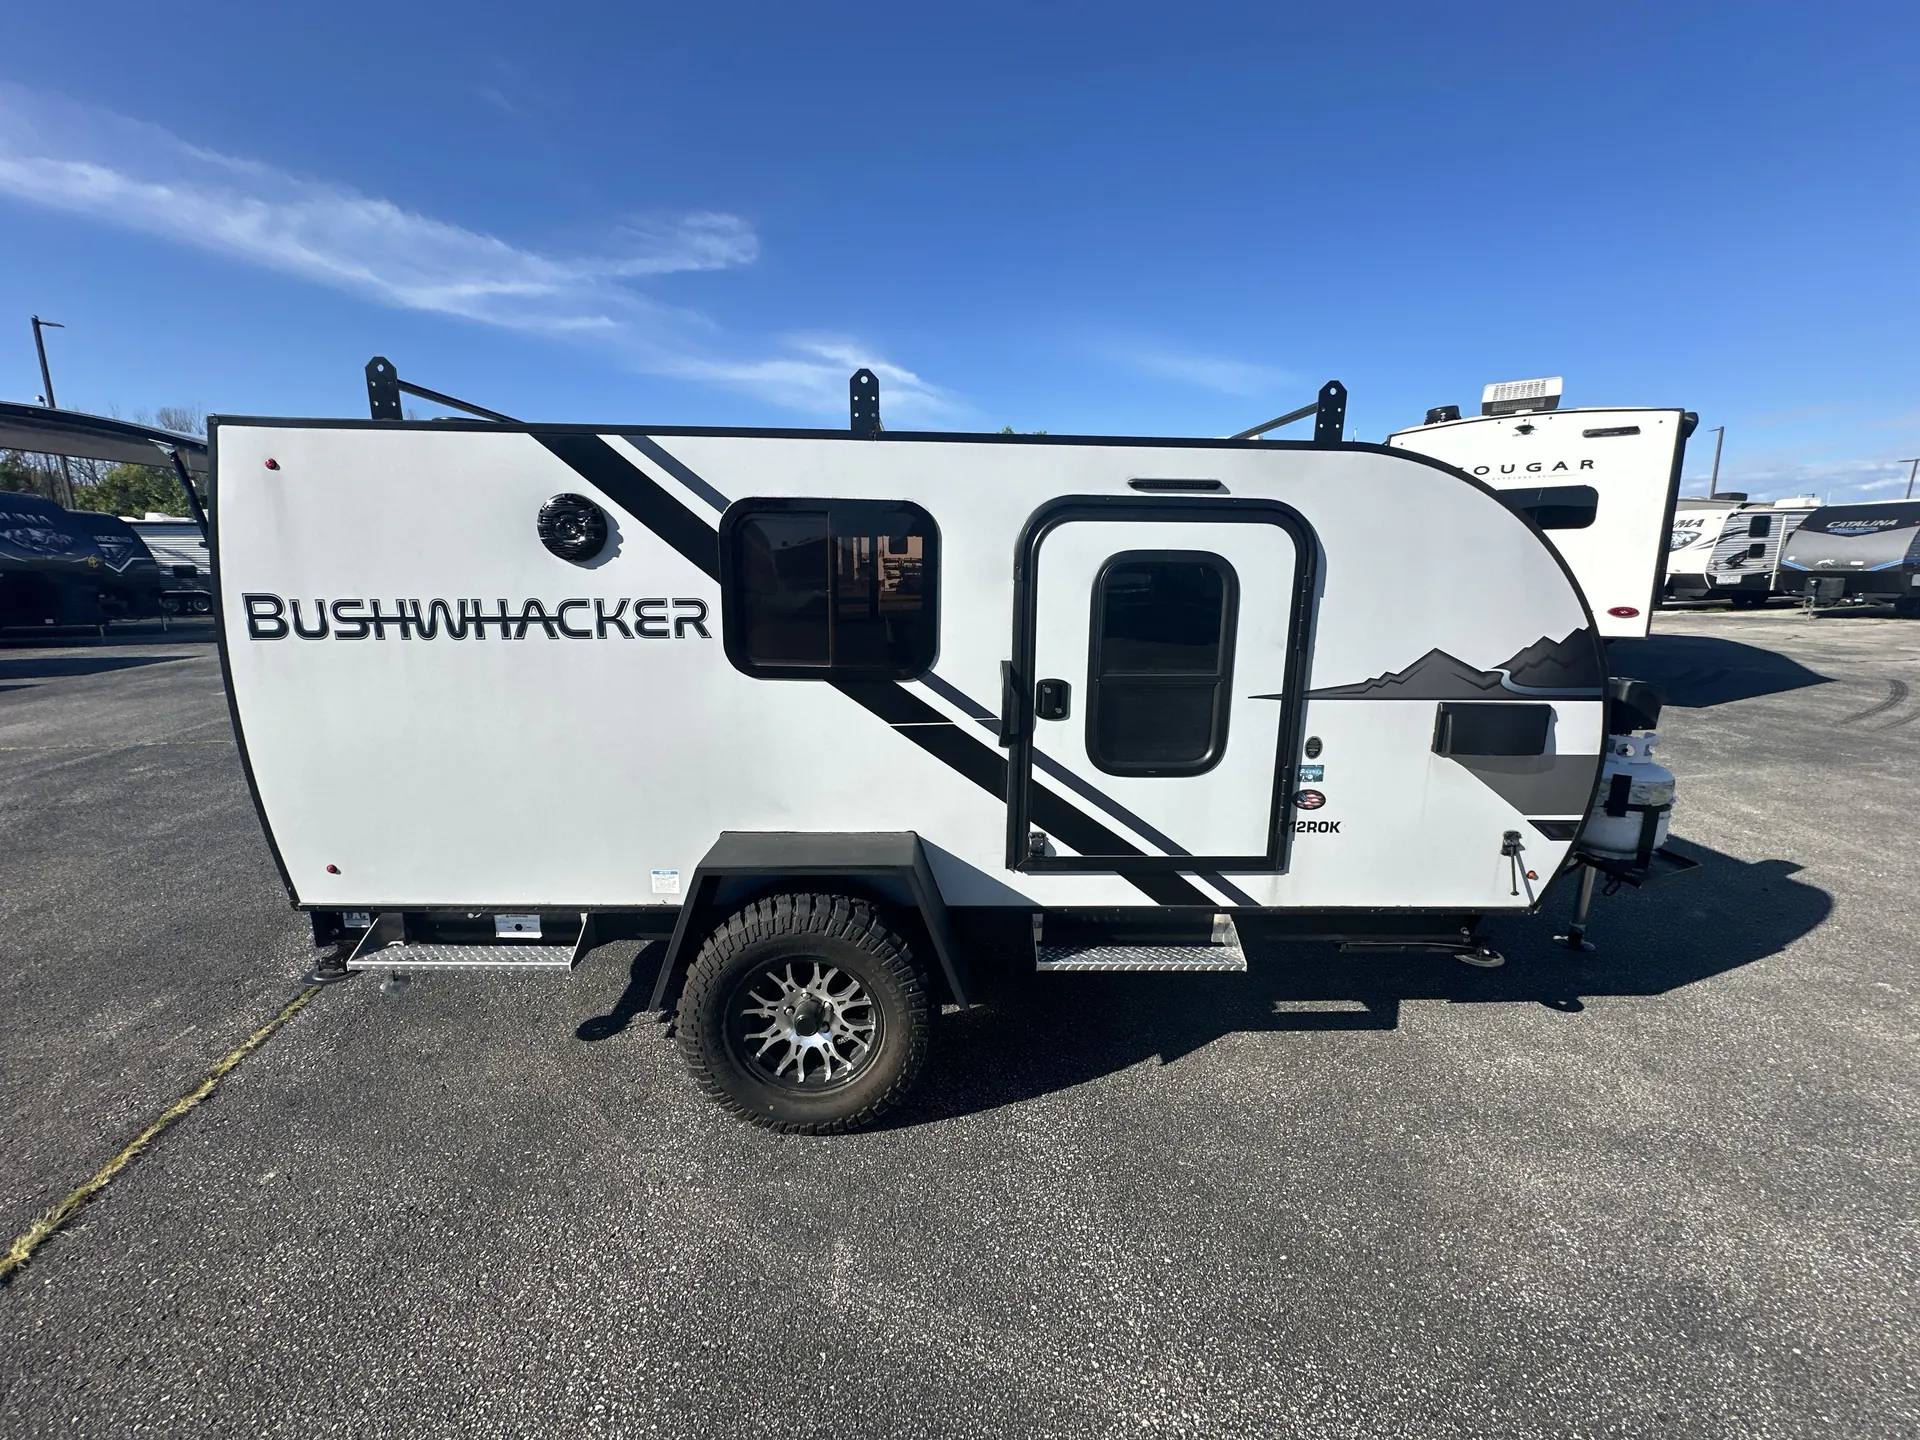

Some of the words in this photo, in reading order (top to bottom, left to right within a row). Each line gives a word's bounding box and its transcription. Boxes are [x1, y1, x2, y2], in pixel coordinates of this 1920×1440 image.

[1456, 459, 1594, 476] OUGAR
[1826, 519, 1899, 528] CATALINA
[241, 592, 713, 640] BUSHWHACKER
[1289, 821, 1341, 833] 12ROK
